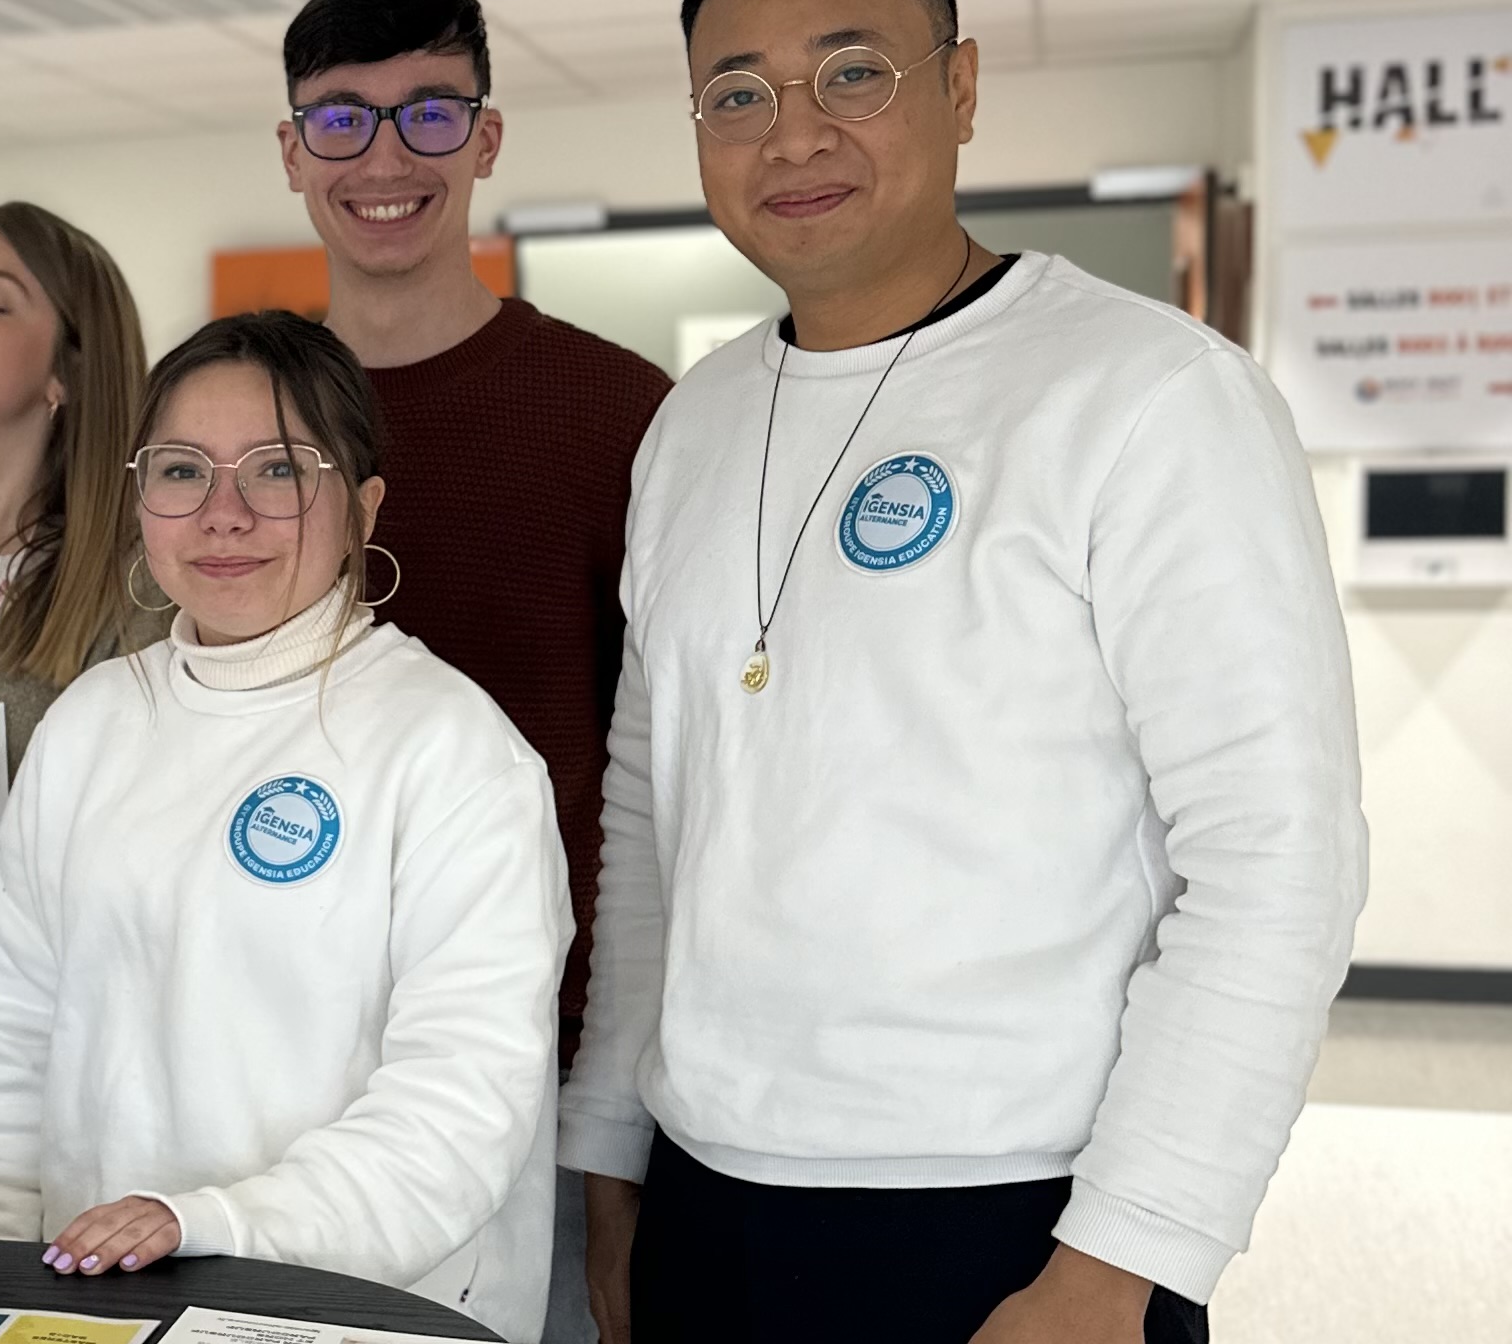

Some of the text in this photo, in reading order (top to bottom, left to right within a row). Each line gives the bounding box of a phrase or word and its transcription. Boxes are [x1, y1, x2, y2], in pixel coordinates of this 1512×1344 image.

[1318, 56, 1501, 132] HALL
[859, 514, 909, 527] ALTERNANCE
[863, 499, 924, 521] IGENSIA
[843, 512, 857, 553] GROUPE
[854, 549, 896, 566] IGENSIA
[899, 507, 947, 562] EDUCATION
[250, 823, 298, 846] ALTERNANCE
[254, 810, 314, 842] IGENSIA
[232, 817, 247, 859] GROUPE
[244, 856, 285, 879] IGENSIA
[286, 833, 335, 878] EDUCATION
